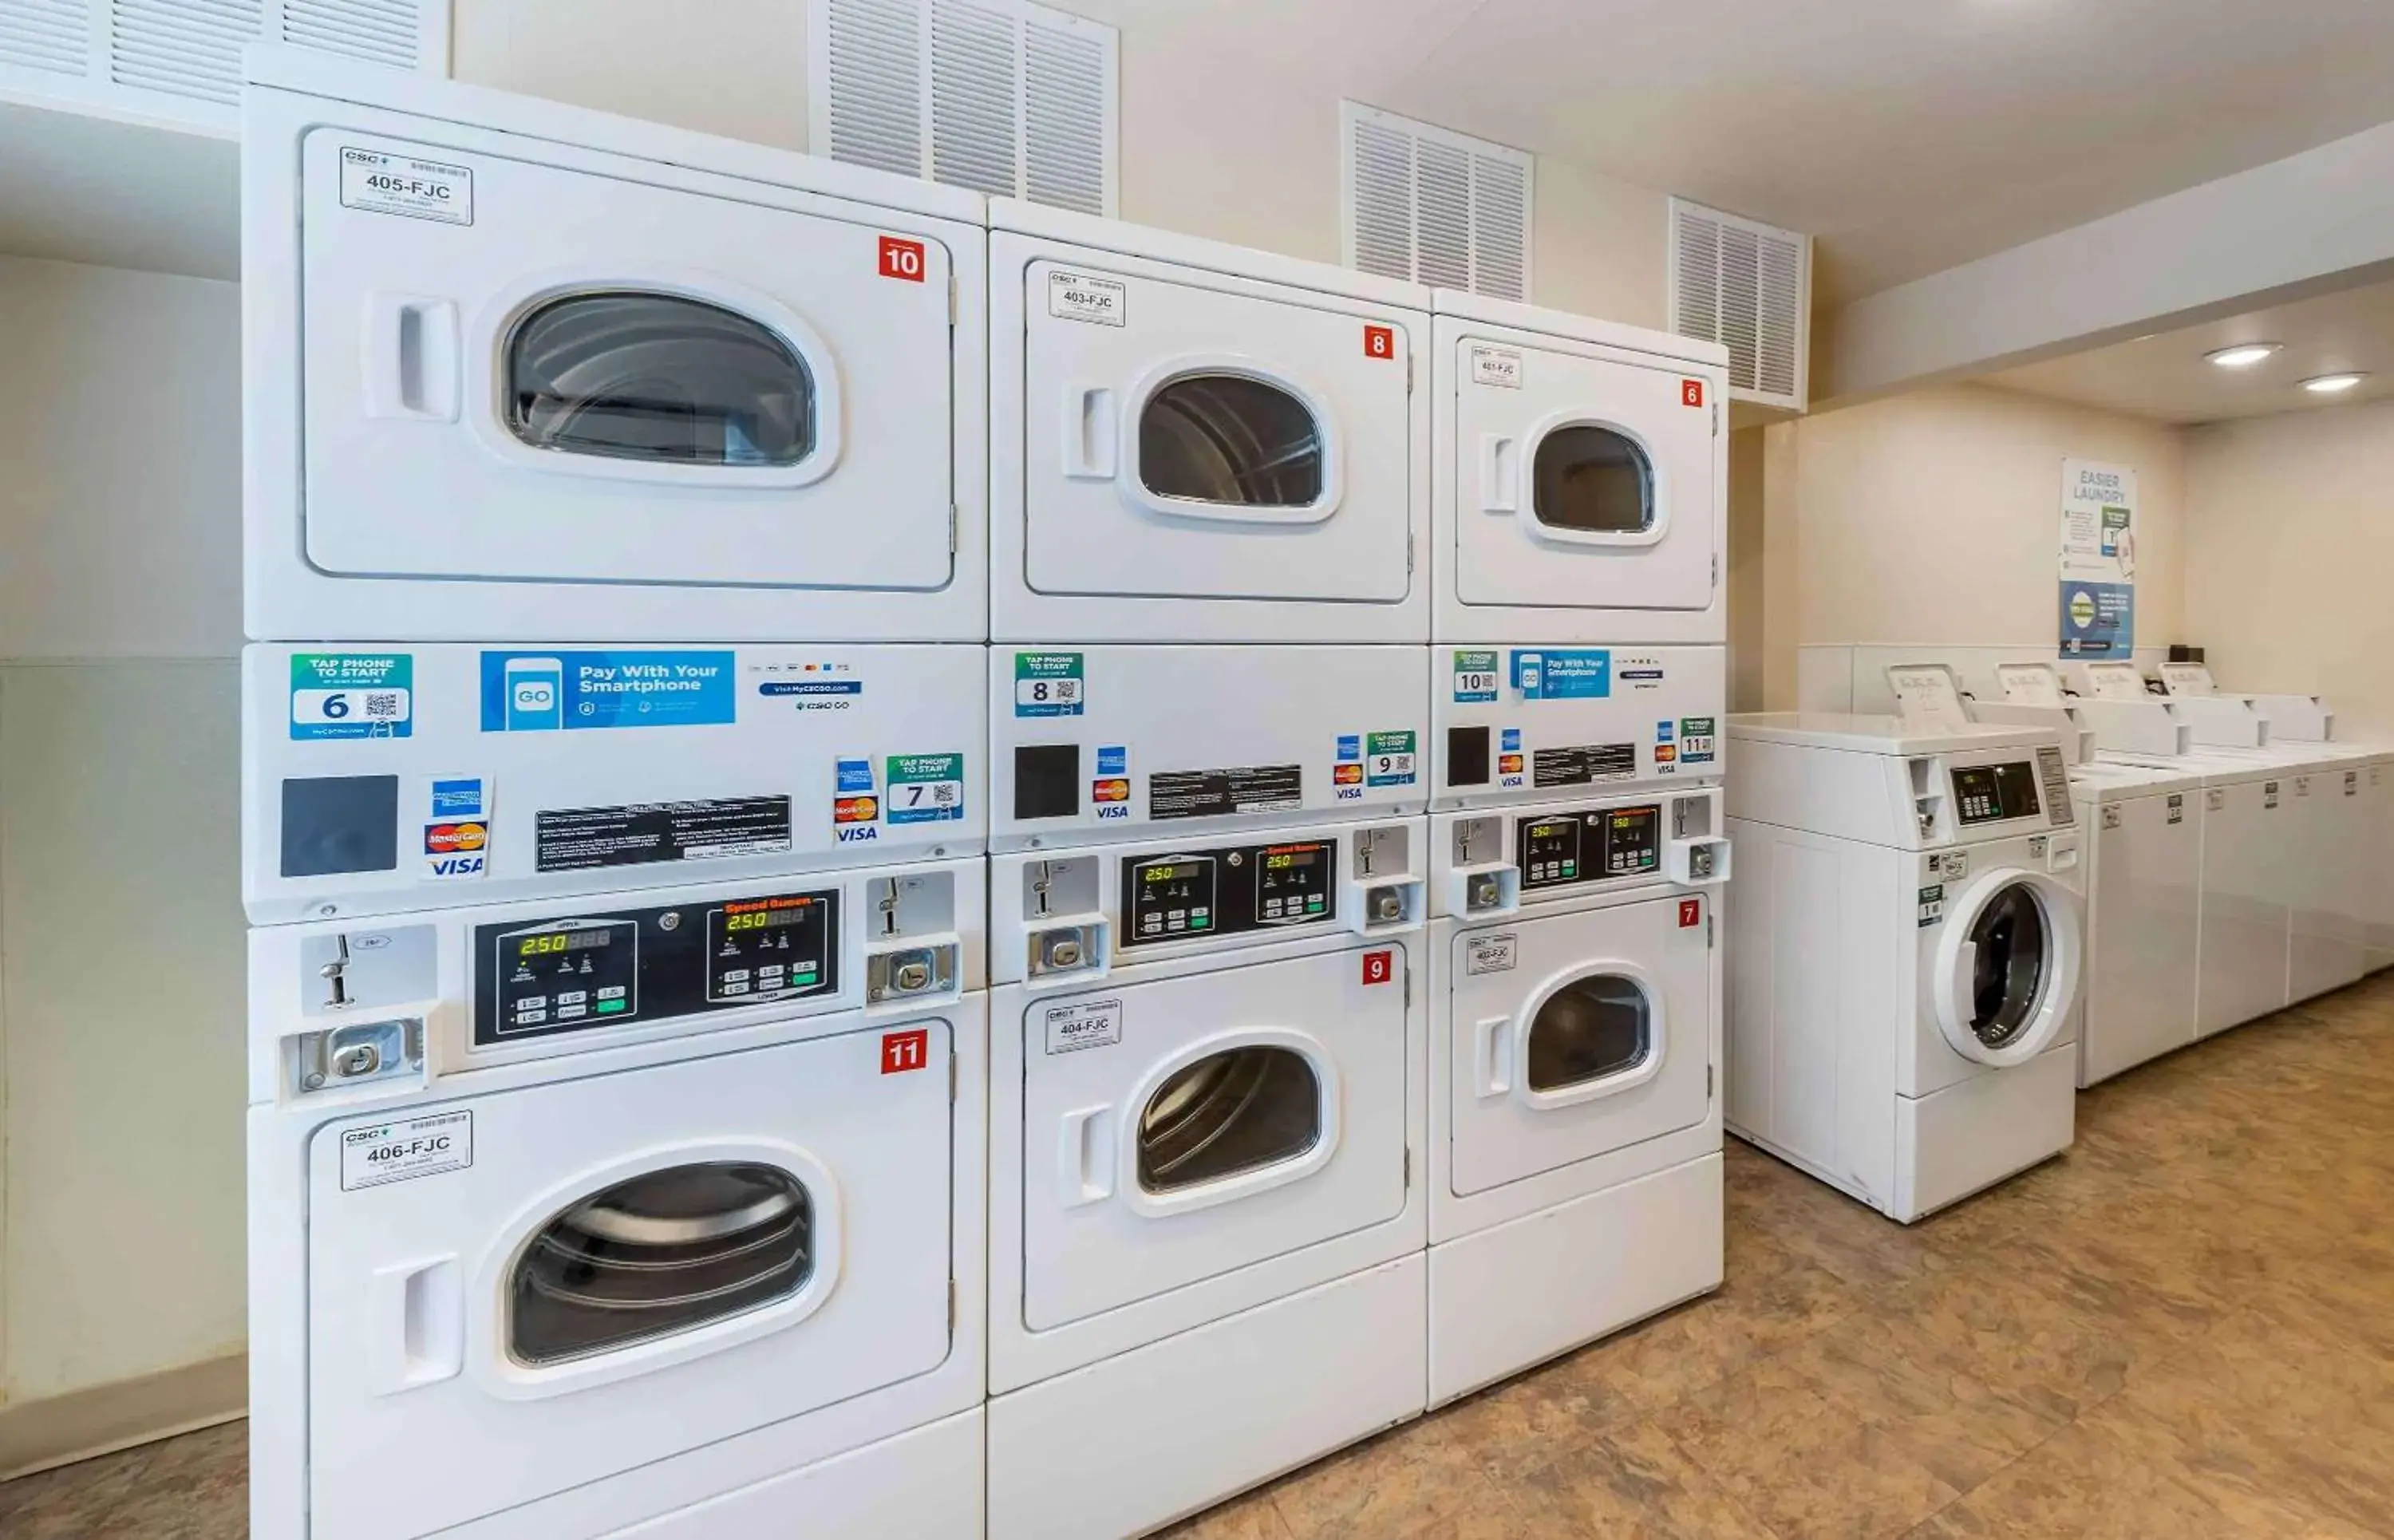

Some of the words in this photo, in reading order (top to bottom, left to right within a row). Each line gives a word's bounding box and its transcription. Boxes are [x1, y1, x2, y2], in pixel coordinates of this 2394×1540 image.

[346, 151, 379, 164] CSC
[366, 175, 451, 199] 405-FJC
[886, 249, 919, 274] 10
[1064, 291, 1112, 308] 403-FJC
[1373, 335, 1385, 353] 8
[1688, 388, 1697, 403] 6
[309, 659, 339, 668] TAP
[342, 659, 395, 668] PHONE
[316, 668, 337, 677] TO
[342, 668, 389, 677] START
[579, 666, 617, 681] Pay
[622, 665, 670, 677] With
[675, 665, 719, 677] Your
[579, 678, 702, 693] Smartphone
[1461, 674, 1480, 690] 10
[518, 689, 551, 703] GO
[1033, 682, 1049, 701] 8
[322, 693, 350, 719] 6
[1685, 738, 1700, 752] 11
[1379, 756, 1391, 773] 9
[1502, 776, 1523, 788] VISA
[907, 786, 923, 807] 7
[1337, 788, 1362, 799] VISA
[1097, 806, 1128, 818] VISA
[838, 827, 878, 842] VISA
[432, 858, 483, 875] VISA
[725, 901, 767, 914] Speed
[1685, 906, 1694, 923] 7
[1372, 960, 1383, 979] 9
[1061, 1018, 1109, 1034] 404-FJC
[890, 1040, 918, 1067] 11
[346, 1128, 379, 1142] CSC
[367, 1135, 451, 1163] 406-FJC
